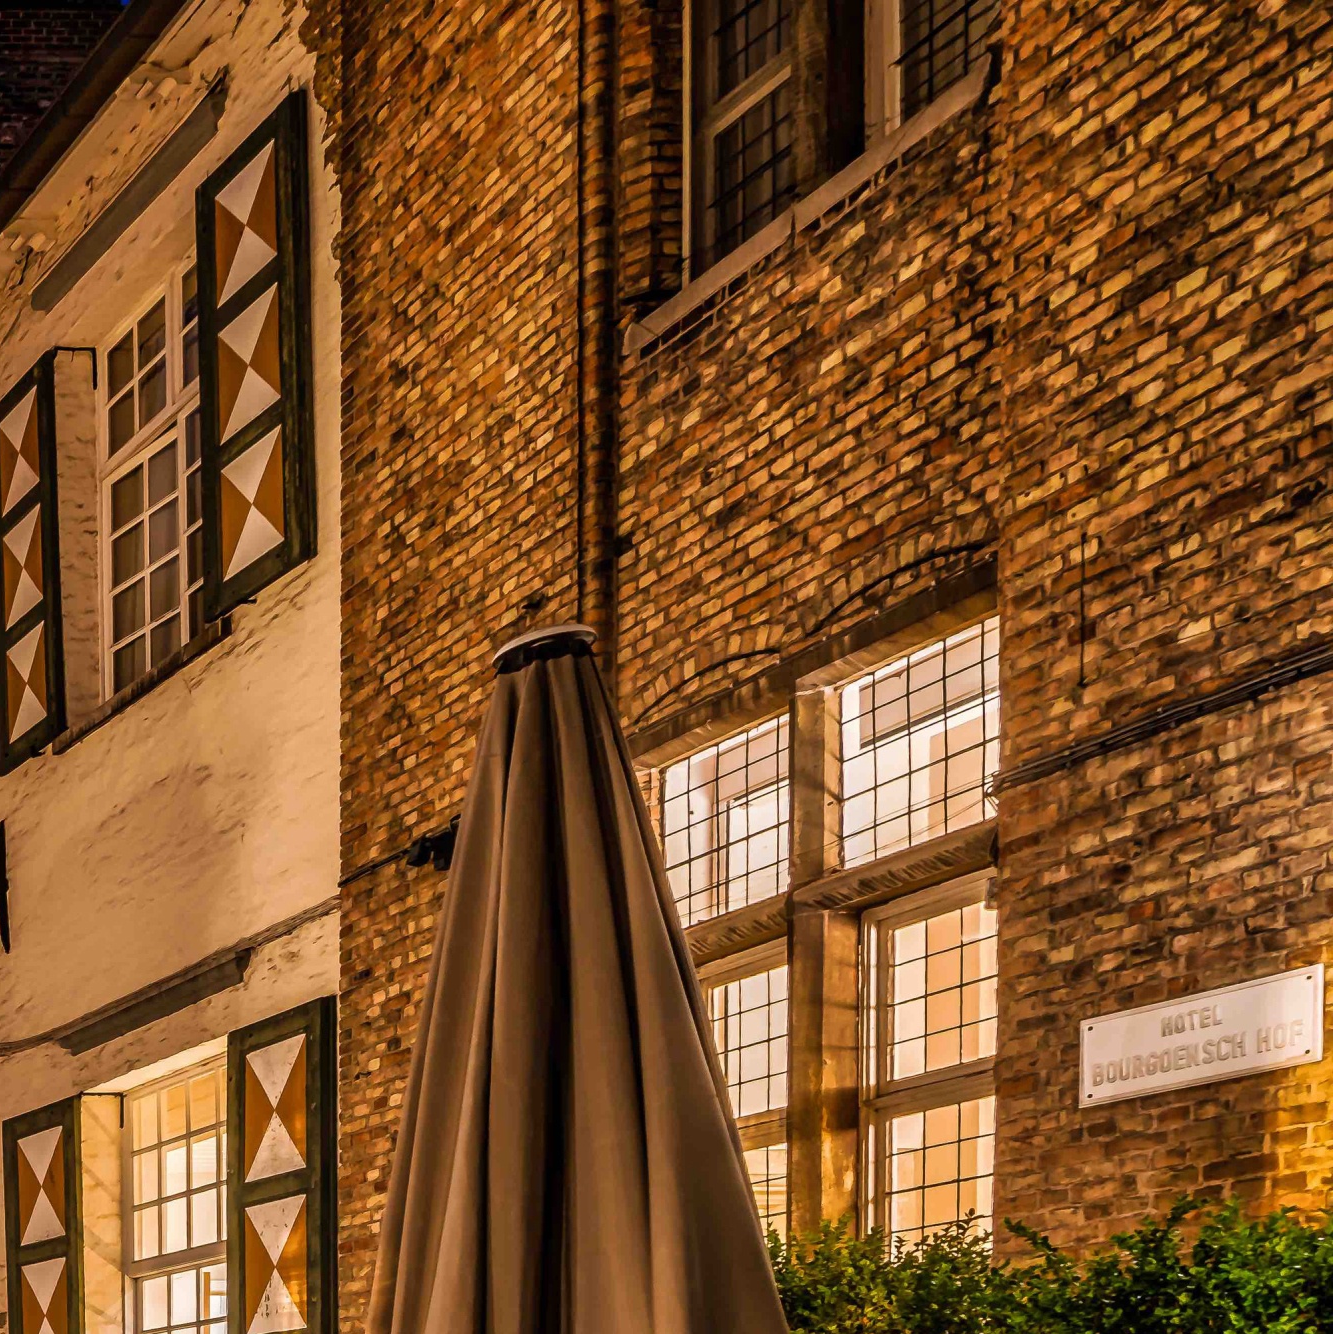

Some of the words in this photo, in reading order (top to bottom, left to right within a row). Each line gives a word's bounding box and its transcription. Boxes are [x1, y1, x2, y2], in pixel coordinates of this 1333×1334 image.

[1161, 1004, 1223, 1037] HOTEL
[1091, 1031, 1247, 1087] BOURGOENSCH
[1257, 1019, 1304, 1054] HOF
